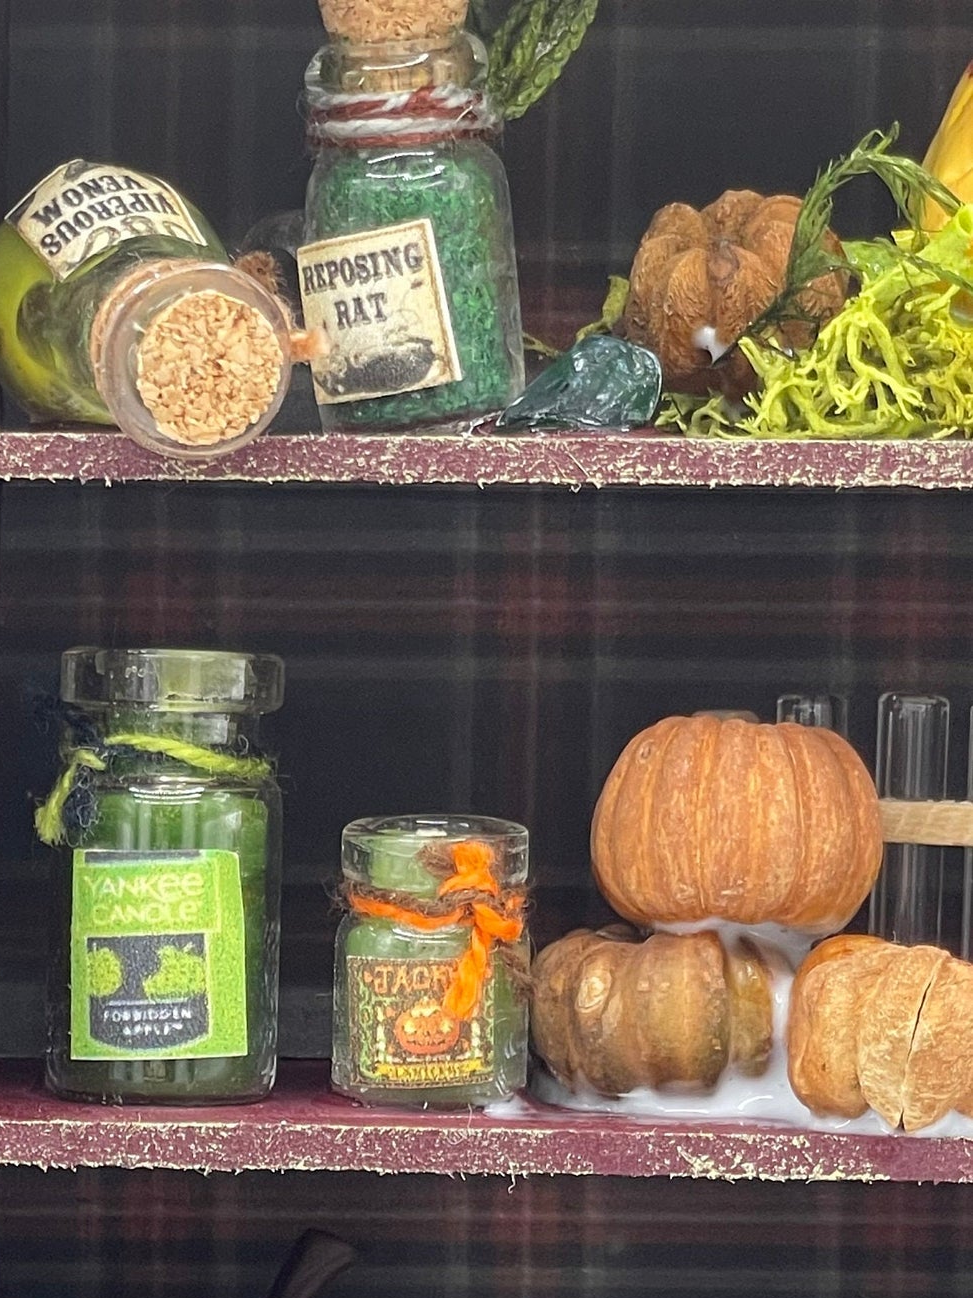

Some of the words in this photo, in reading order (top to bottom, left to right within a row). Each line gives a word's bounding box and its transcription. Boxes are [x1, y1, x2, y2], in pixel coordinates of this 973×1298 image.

[30, 175, 147, 228] VENOM
[41, 193, 179, 256] VIPEROUS
[303, 242, 424, 295] REPOSING
[334, 292, 388, 330] RAT
[103, 1006, 192, 1022] FORBIDDEN
